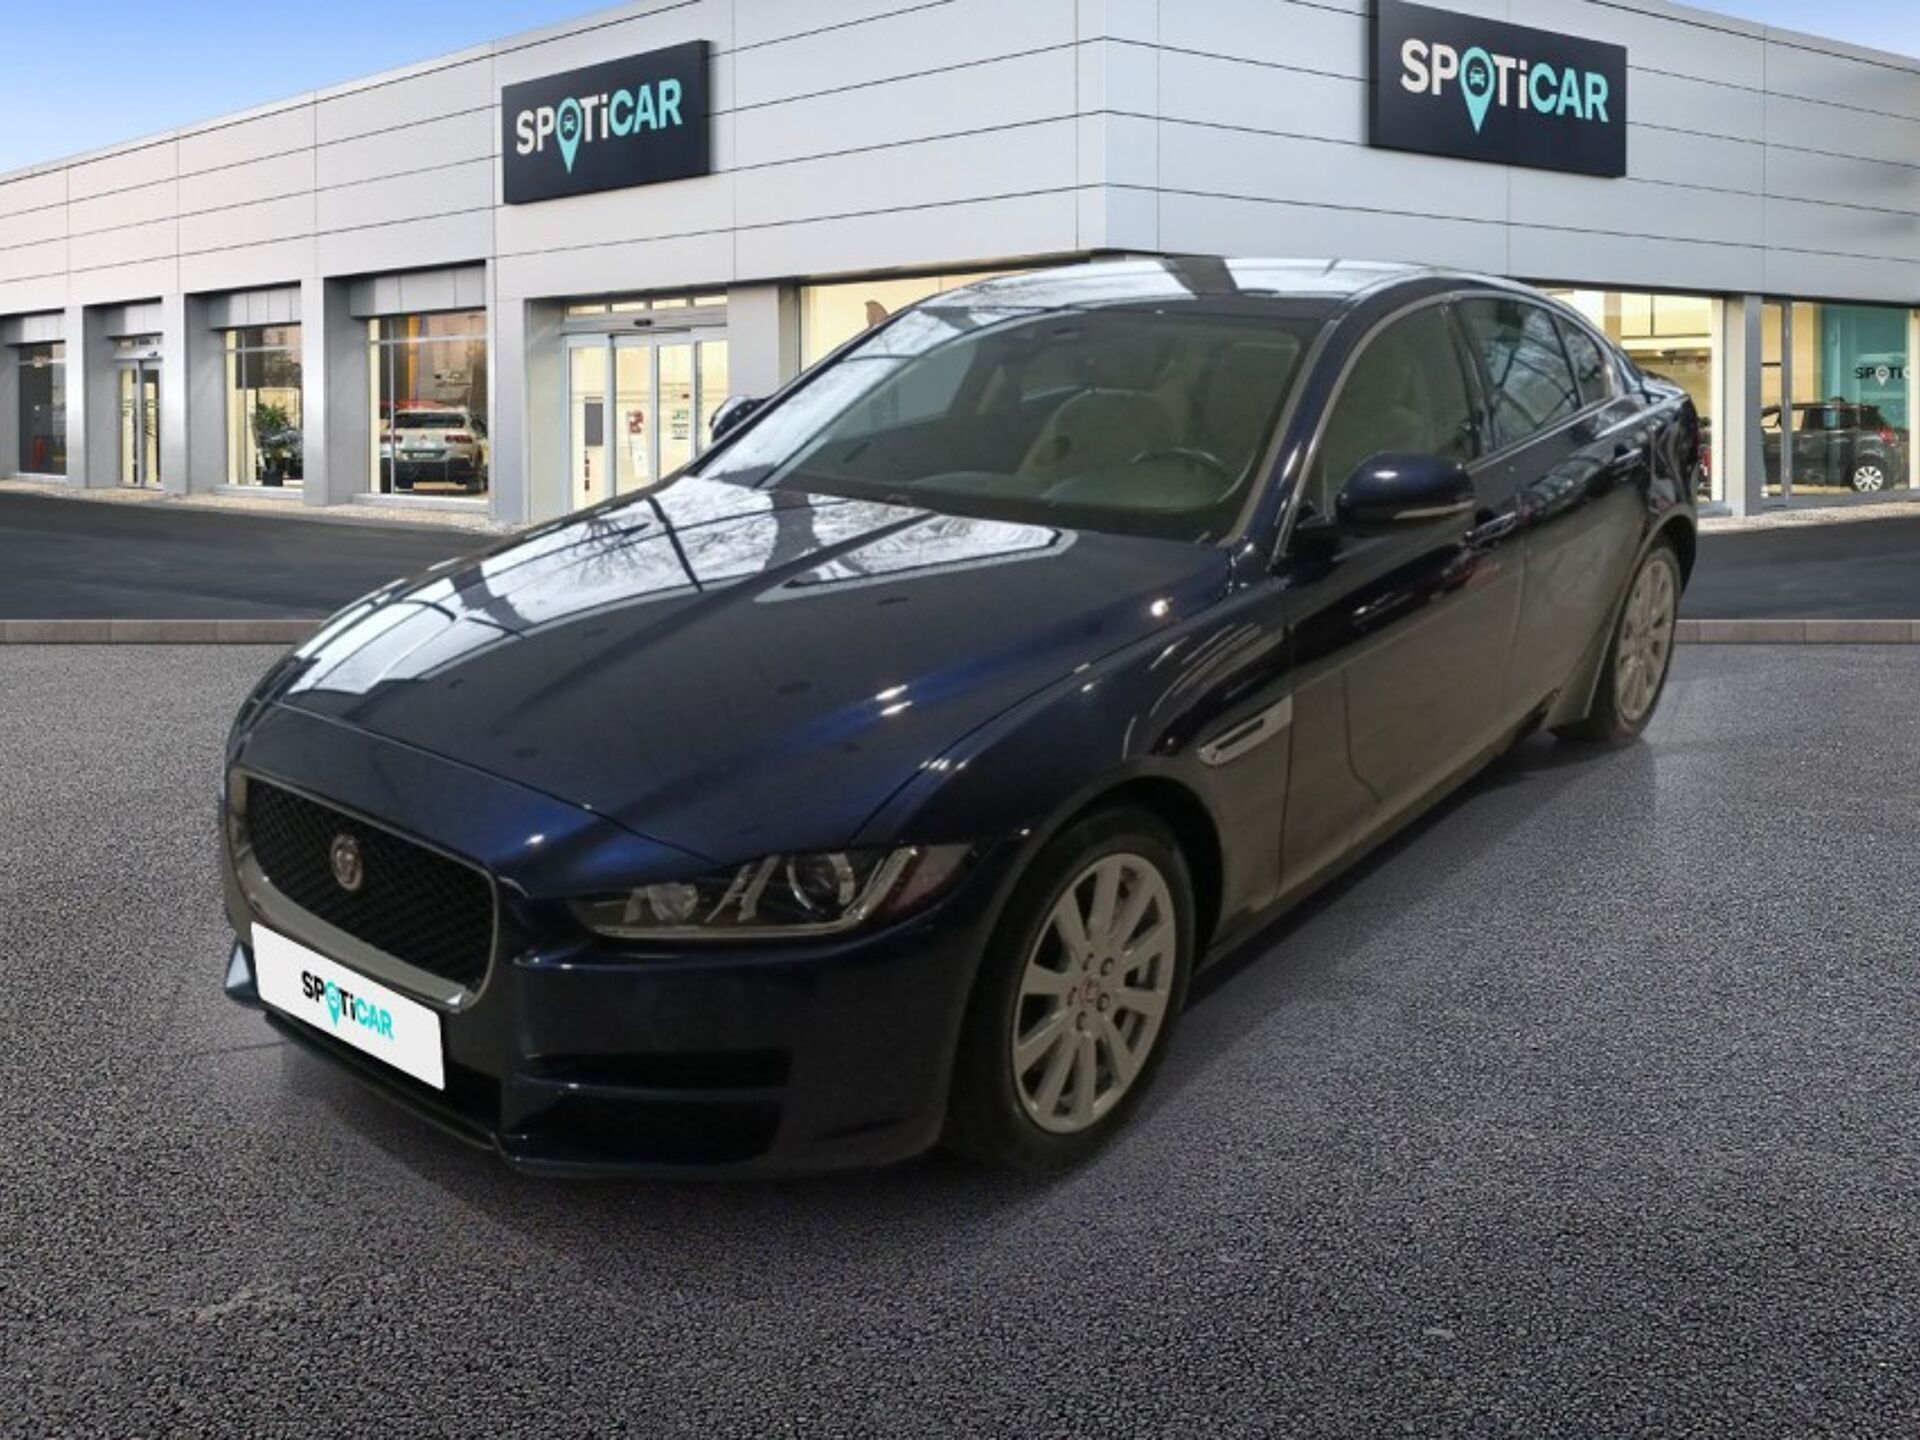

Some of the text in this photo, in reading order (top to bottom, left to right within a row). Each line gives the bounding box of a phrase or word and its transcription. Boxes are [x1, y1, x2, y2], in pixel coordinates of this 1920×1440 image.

[516, 78, 683, 174] SPOTiCAR
[1401, 38, 1609, 134] SPOTiCAR
[301, 970, 394, 1040] SPOTiCAR
